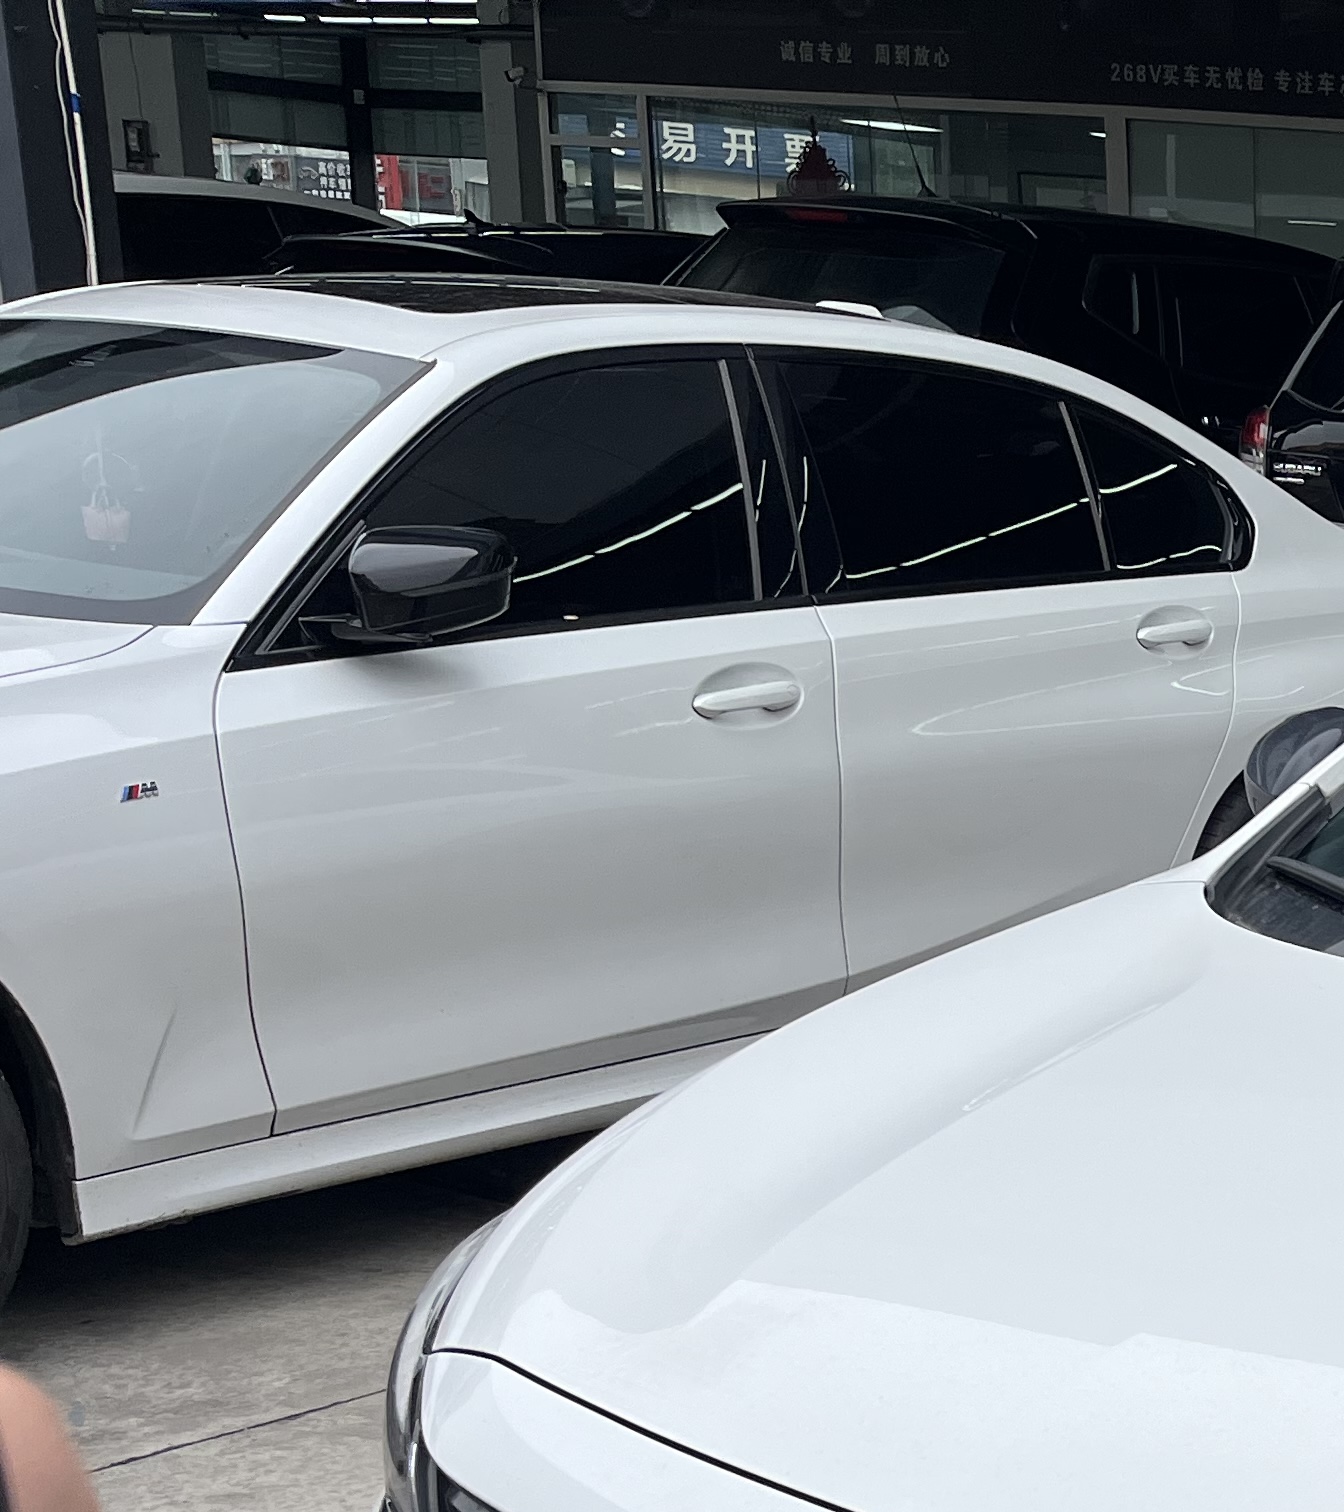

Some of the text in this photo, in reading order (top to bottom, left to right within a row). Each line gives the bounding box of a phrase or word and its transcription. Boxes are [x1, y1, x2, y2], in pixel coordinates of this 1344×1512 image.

[780, 41, 951, 68] 诚信专业 周到放心
[1110, 62, 1264, 92] 268V买车无忧检
